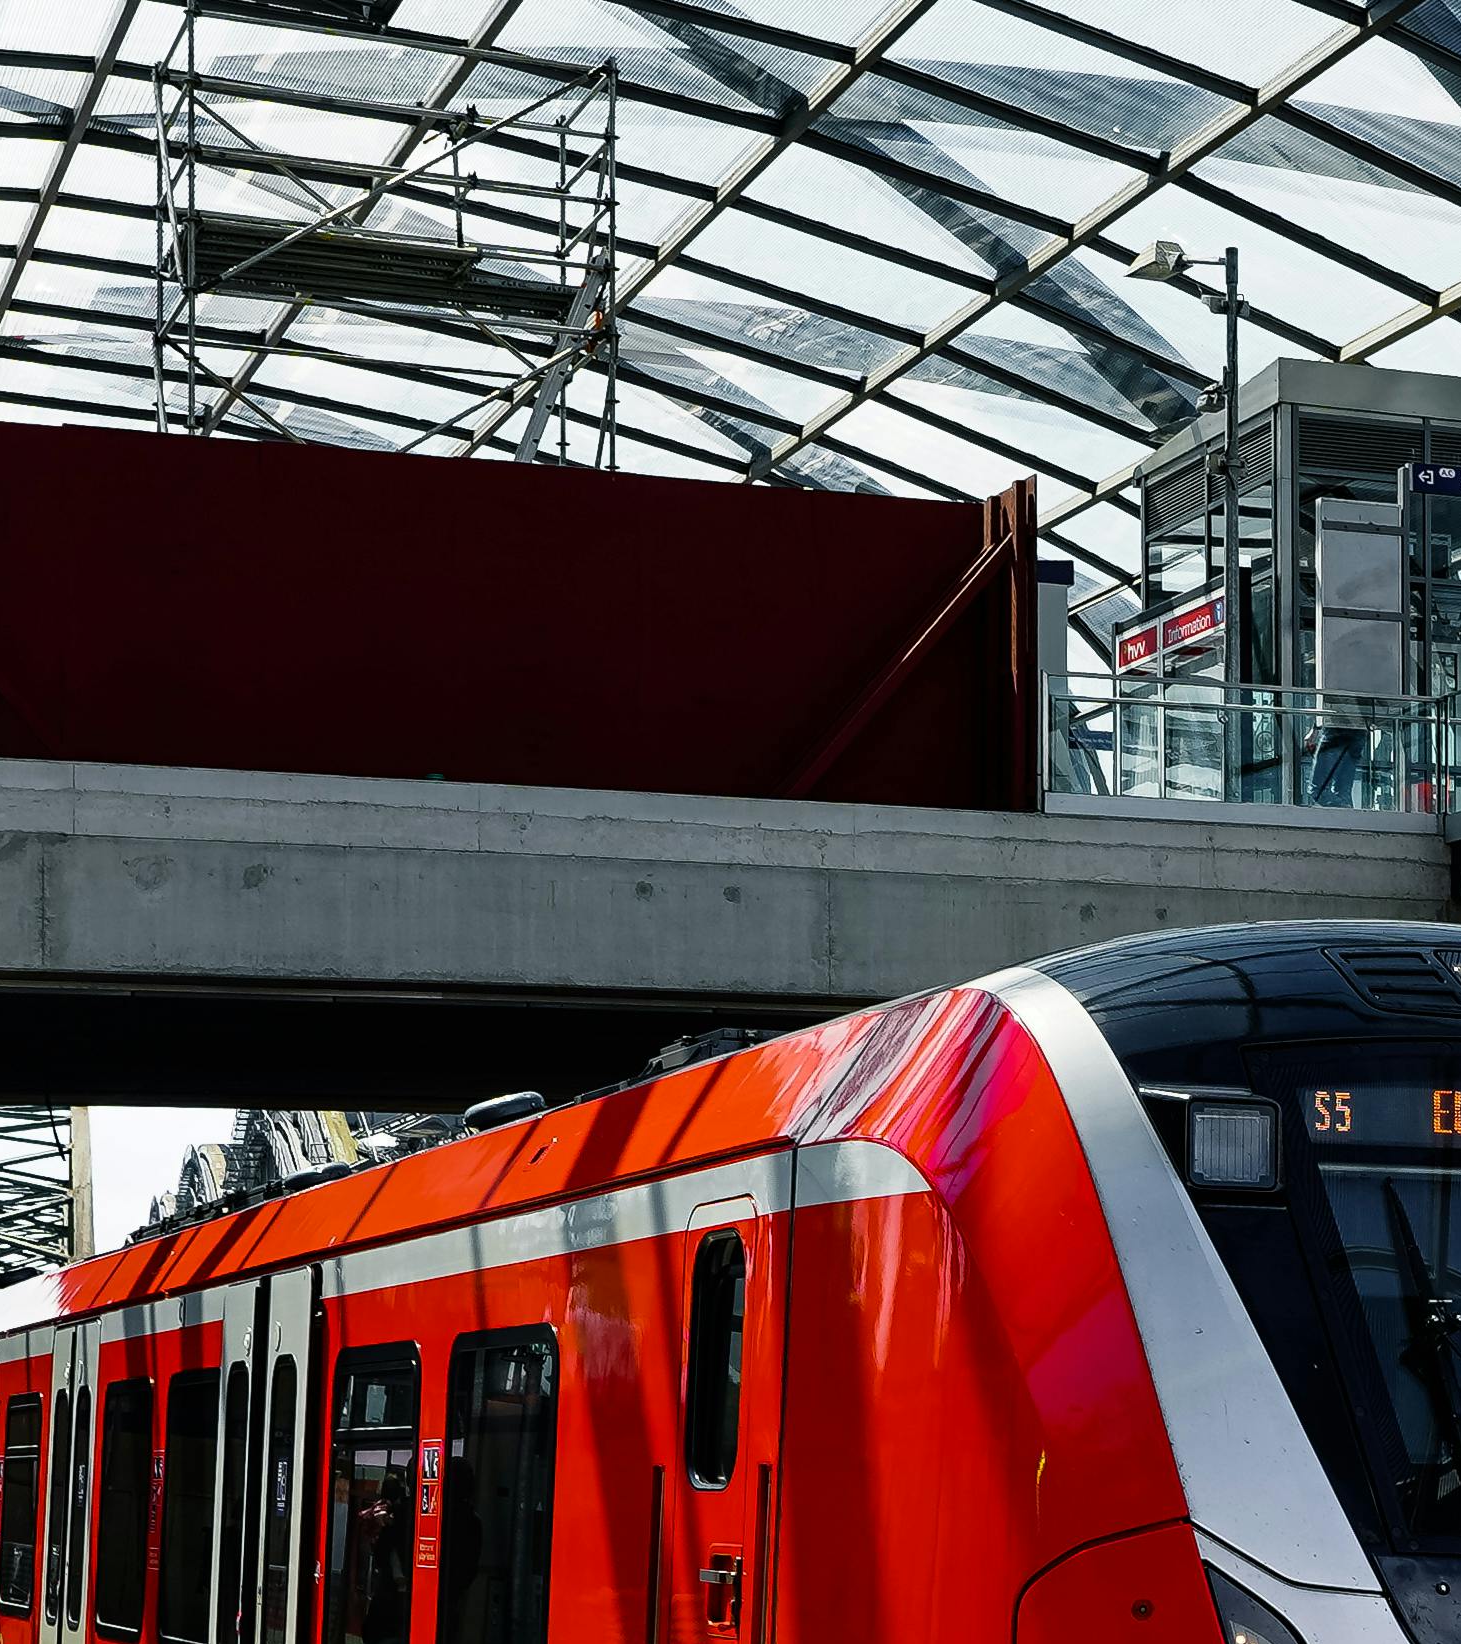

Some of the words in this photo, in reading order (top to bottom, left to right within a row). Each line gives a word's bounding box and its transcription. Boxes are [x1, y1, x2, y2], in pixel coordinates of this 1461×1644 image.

[1127, 640, 1146, 661] hvv
[1167, 614, 1211, 644] Information
[1314, 1091, 1351, 1133] S5
